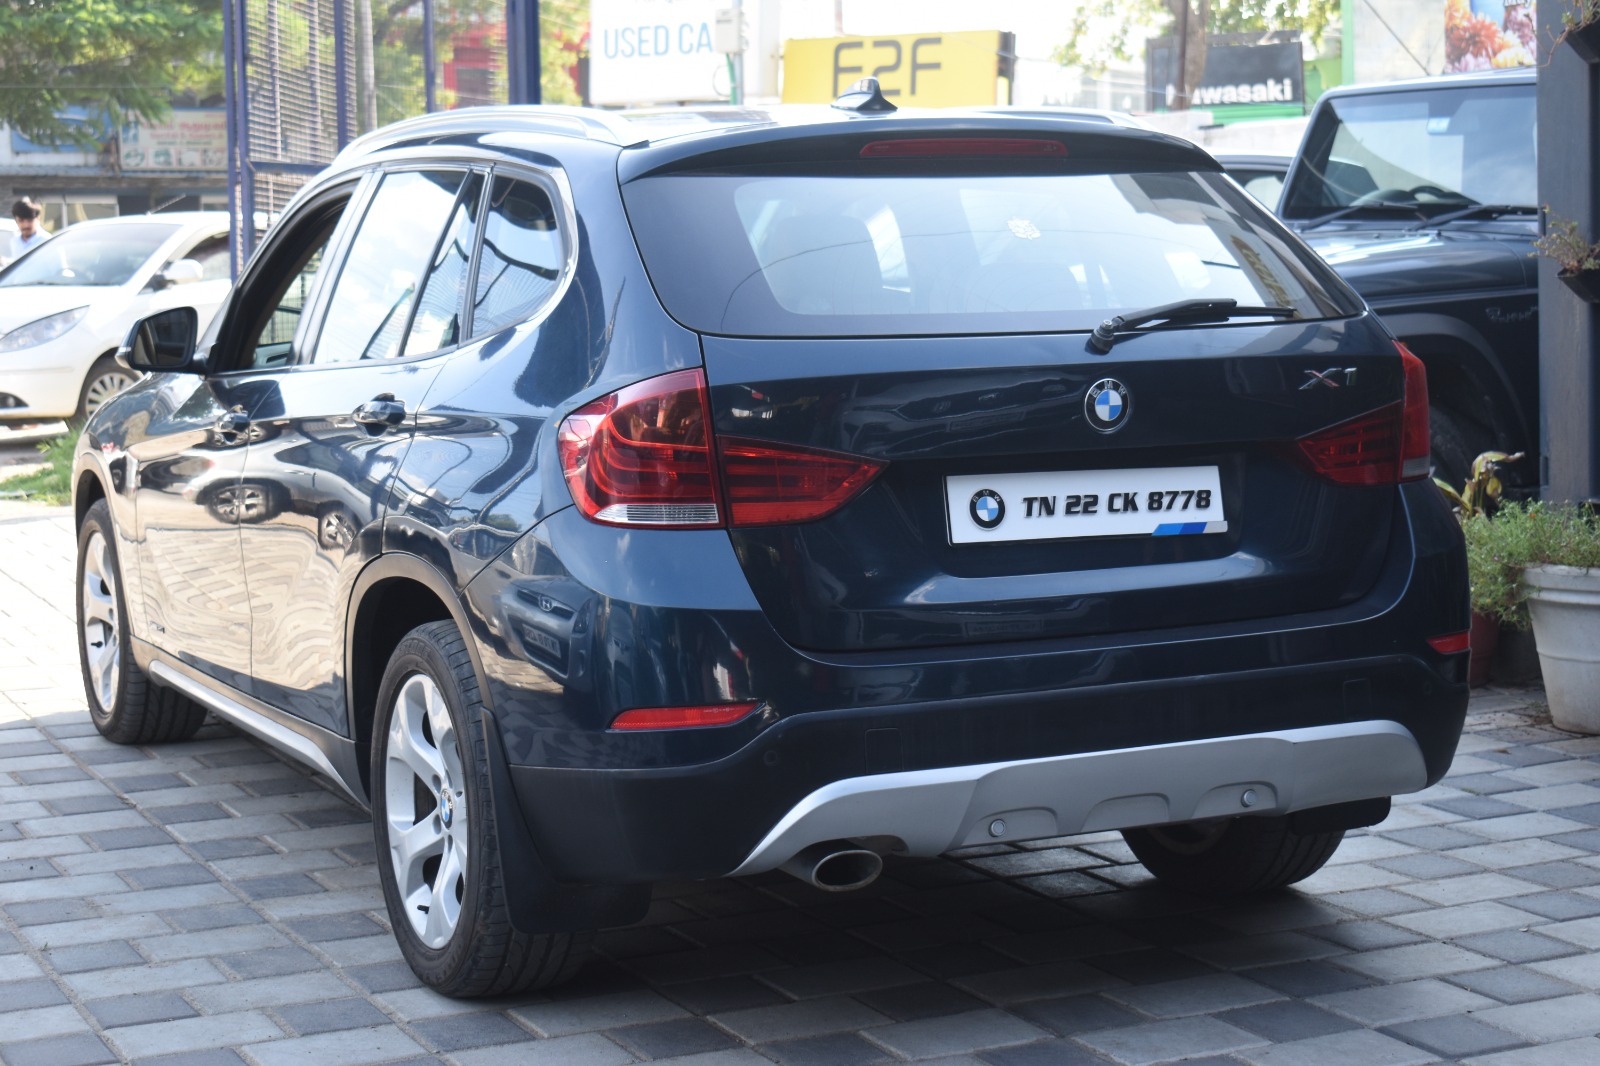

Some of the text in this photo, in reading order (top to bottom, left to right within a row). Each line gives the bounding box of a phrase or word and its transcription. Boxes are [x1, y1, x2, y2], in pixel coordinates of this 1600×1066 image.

[604, 22, 713, 59] USED CA
[1089, 379, 1127, 398] BMW
[1299, 367, 1357, 390] X1
[971, 489, 1001, 503] BMW
[1022, 489, 1212, 518] TN 22 CK 8778
